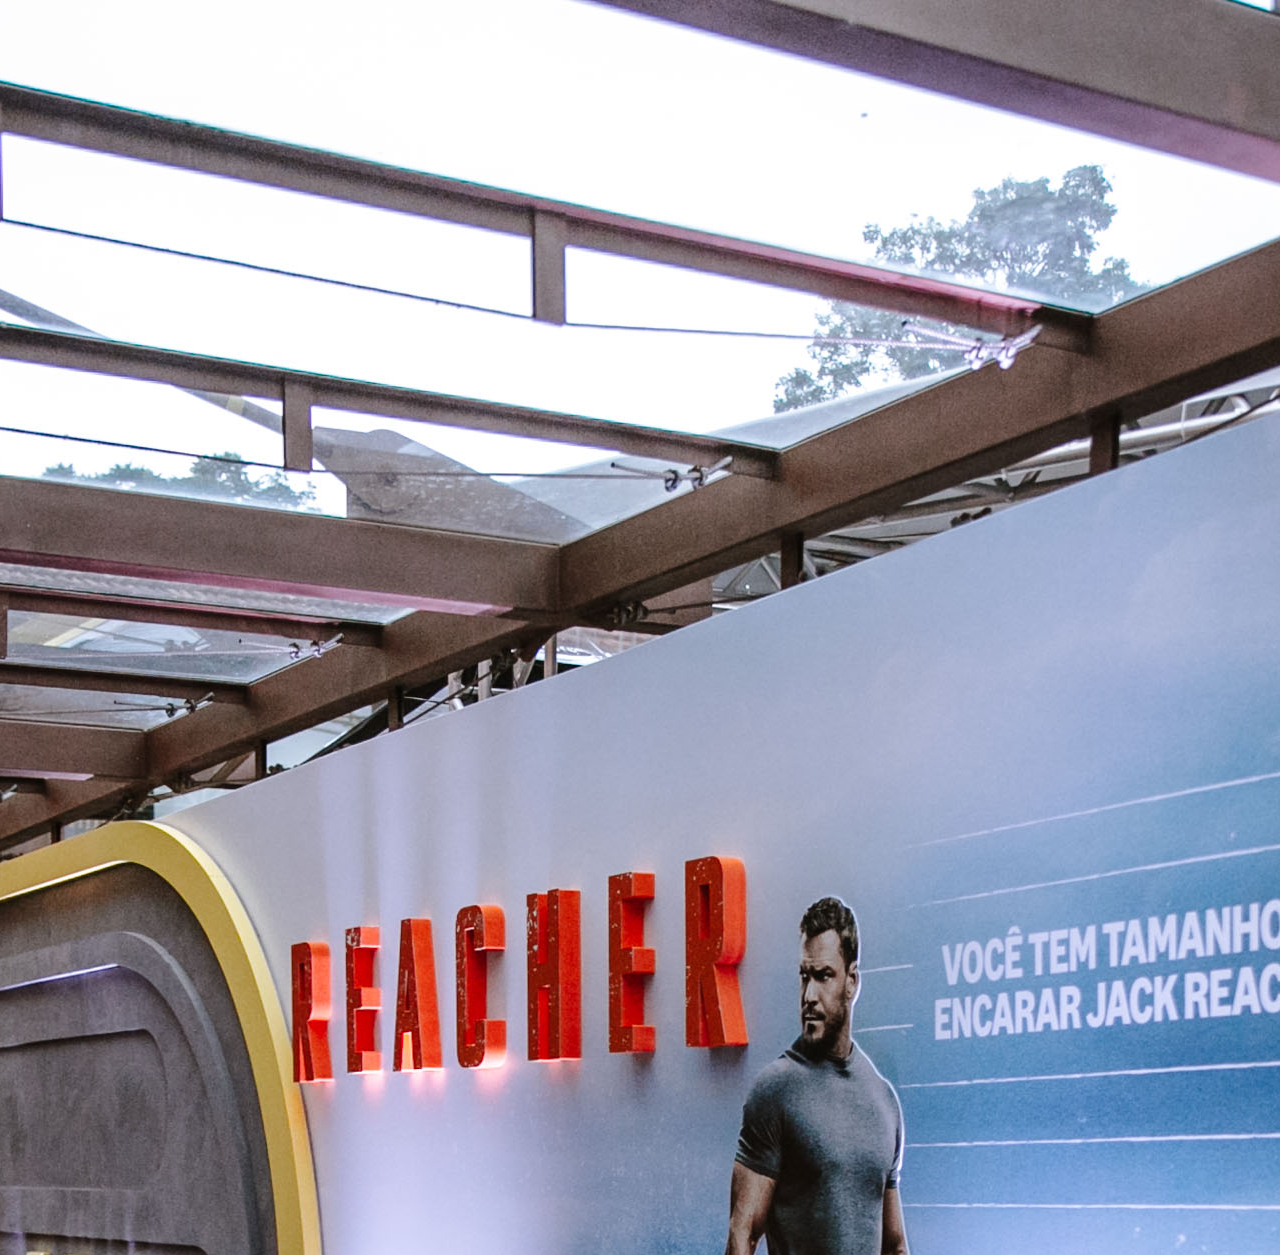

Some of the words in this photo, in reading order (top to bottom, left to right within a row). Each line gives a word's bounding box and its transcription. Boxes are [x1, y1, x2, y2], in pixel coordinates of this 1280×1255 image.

[291, 856, 749, 1082] REACHER
[941, 925, 1023, 986] VOCÊ
[1028, 924, 1097, 977] TEM
[934, 985, 1083, 1041] ENCARAR
[1086, 973, 1179, 1028] JACK
